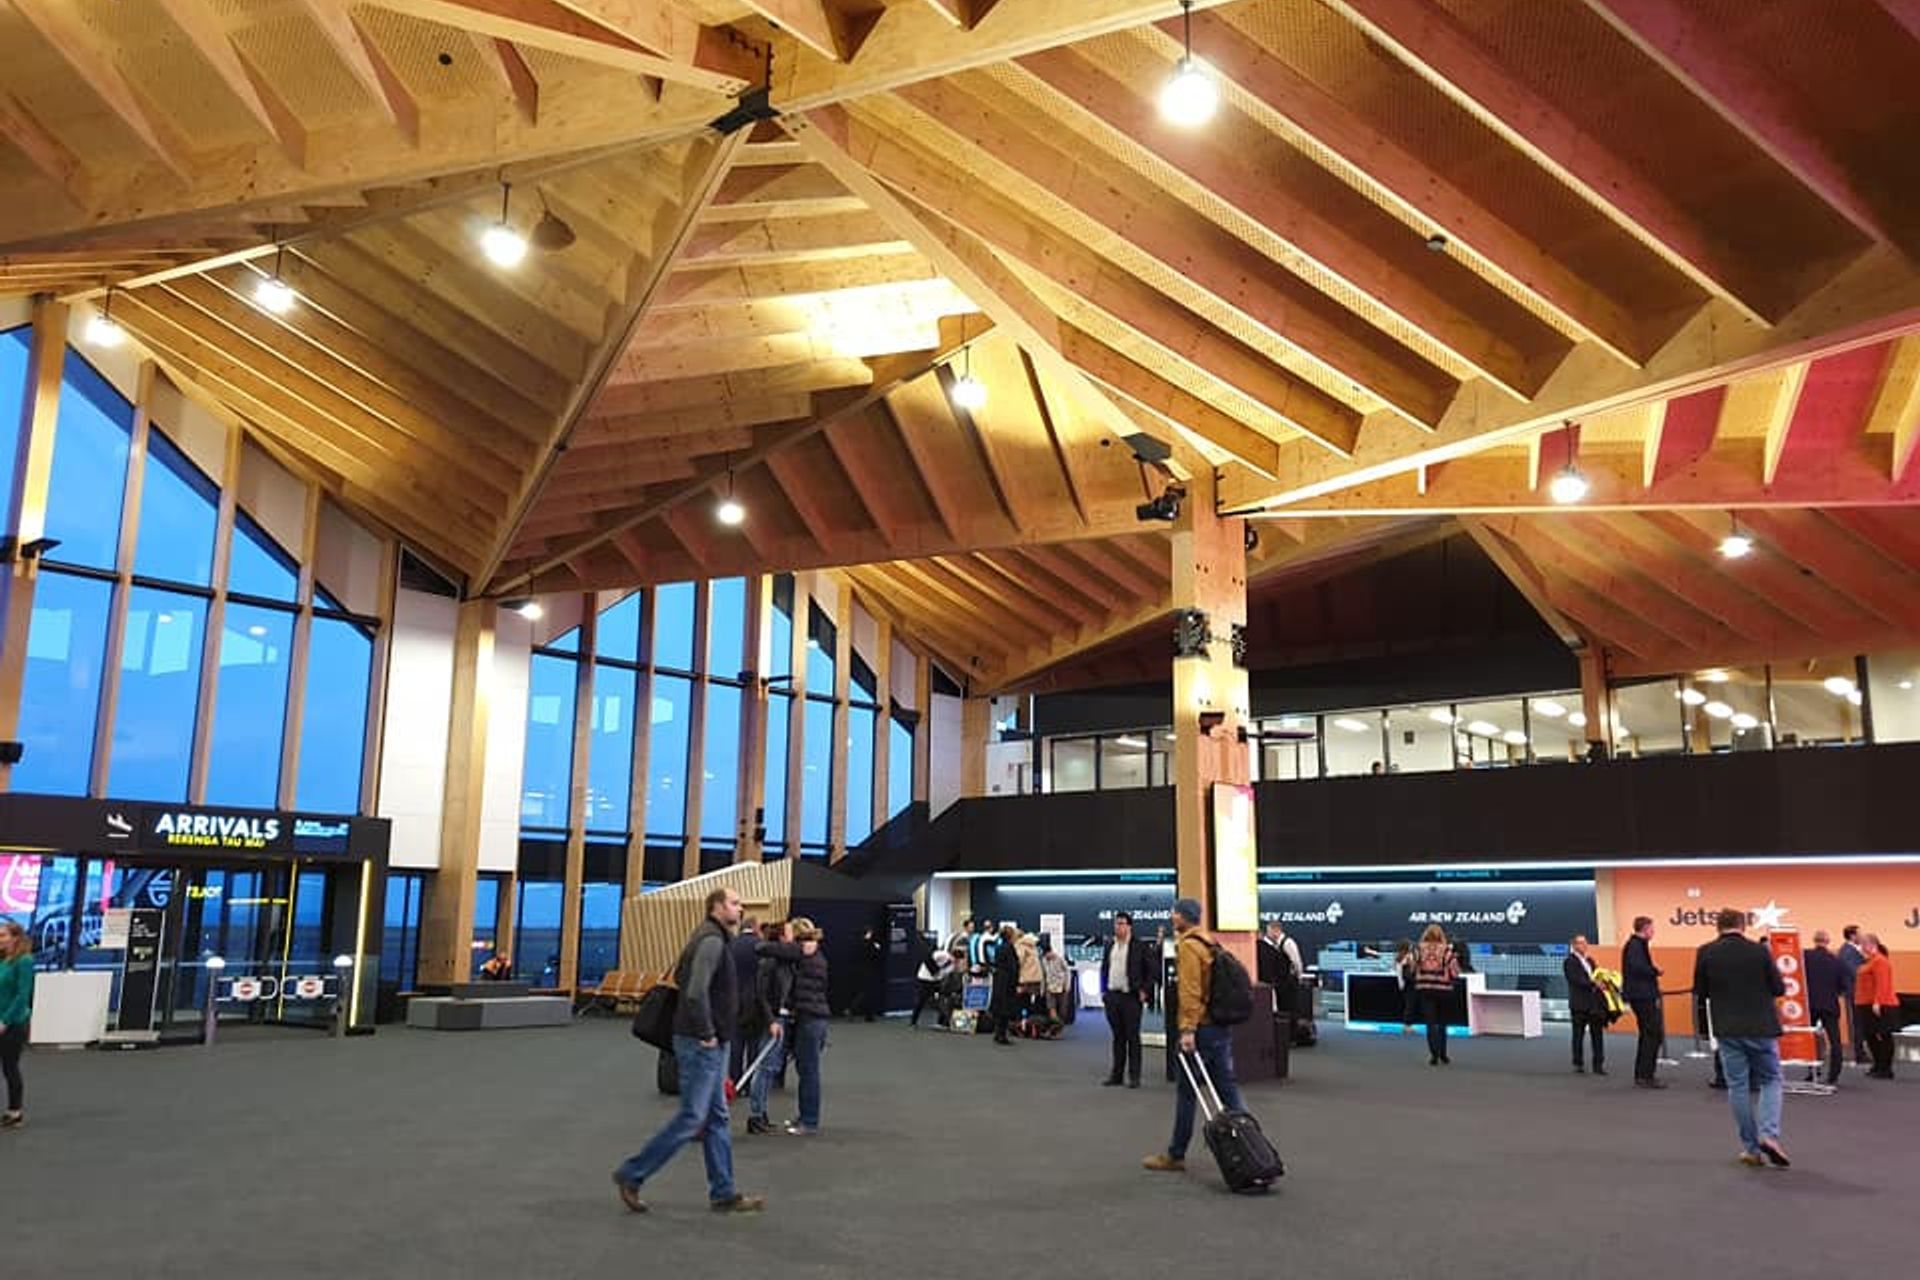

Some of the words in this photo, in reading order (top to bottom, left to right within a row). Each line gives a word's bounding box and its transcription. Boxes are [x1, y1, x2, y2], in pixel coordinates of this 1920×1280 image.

[155, 813, 280, 840] ARRIVALS
[1282, 911, 1326, 922] ZEALAND
[1409, 911, 1428, 922] AIR
[1430, 911, 1454, 922] NEW
[1454, 911, 1506, 923] ZEALAND
